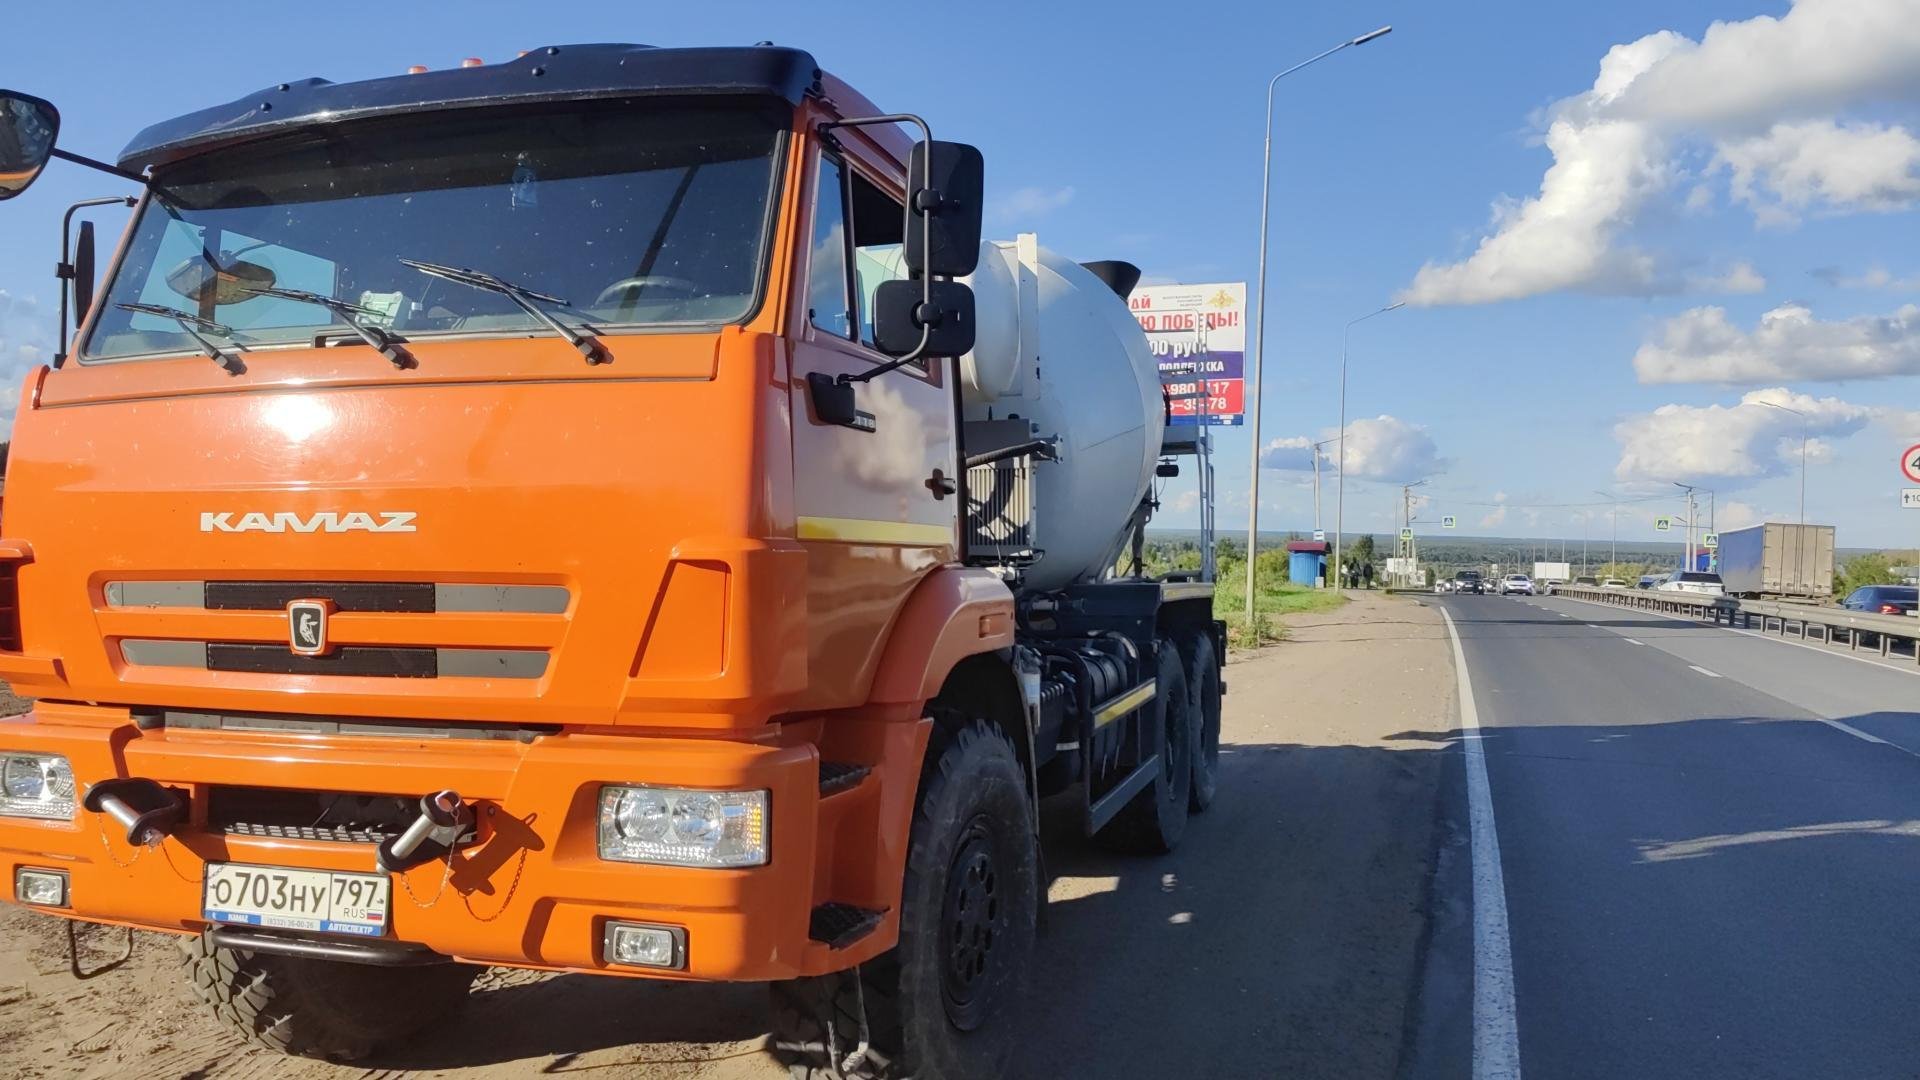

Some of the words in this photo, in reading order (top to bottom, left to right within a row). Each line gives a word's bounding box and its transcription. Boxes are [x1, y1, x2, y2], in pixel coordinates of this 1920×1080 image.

[1138, 315, 1156, 331] Ю
[1162, 311, 1239, 331] ПОБЕДЫ!
[200, 511, 417, 533] KAMAZ
[333, 878, 378, 908] 797
[343, 908, 366, 918] RUS
